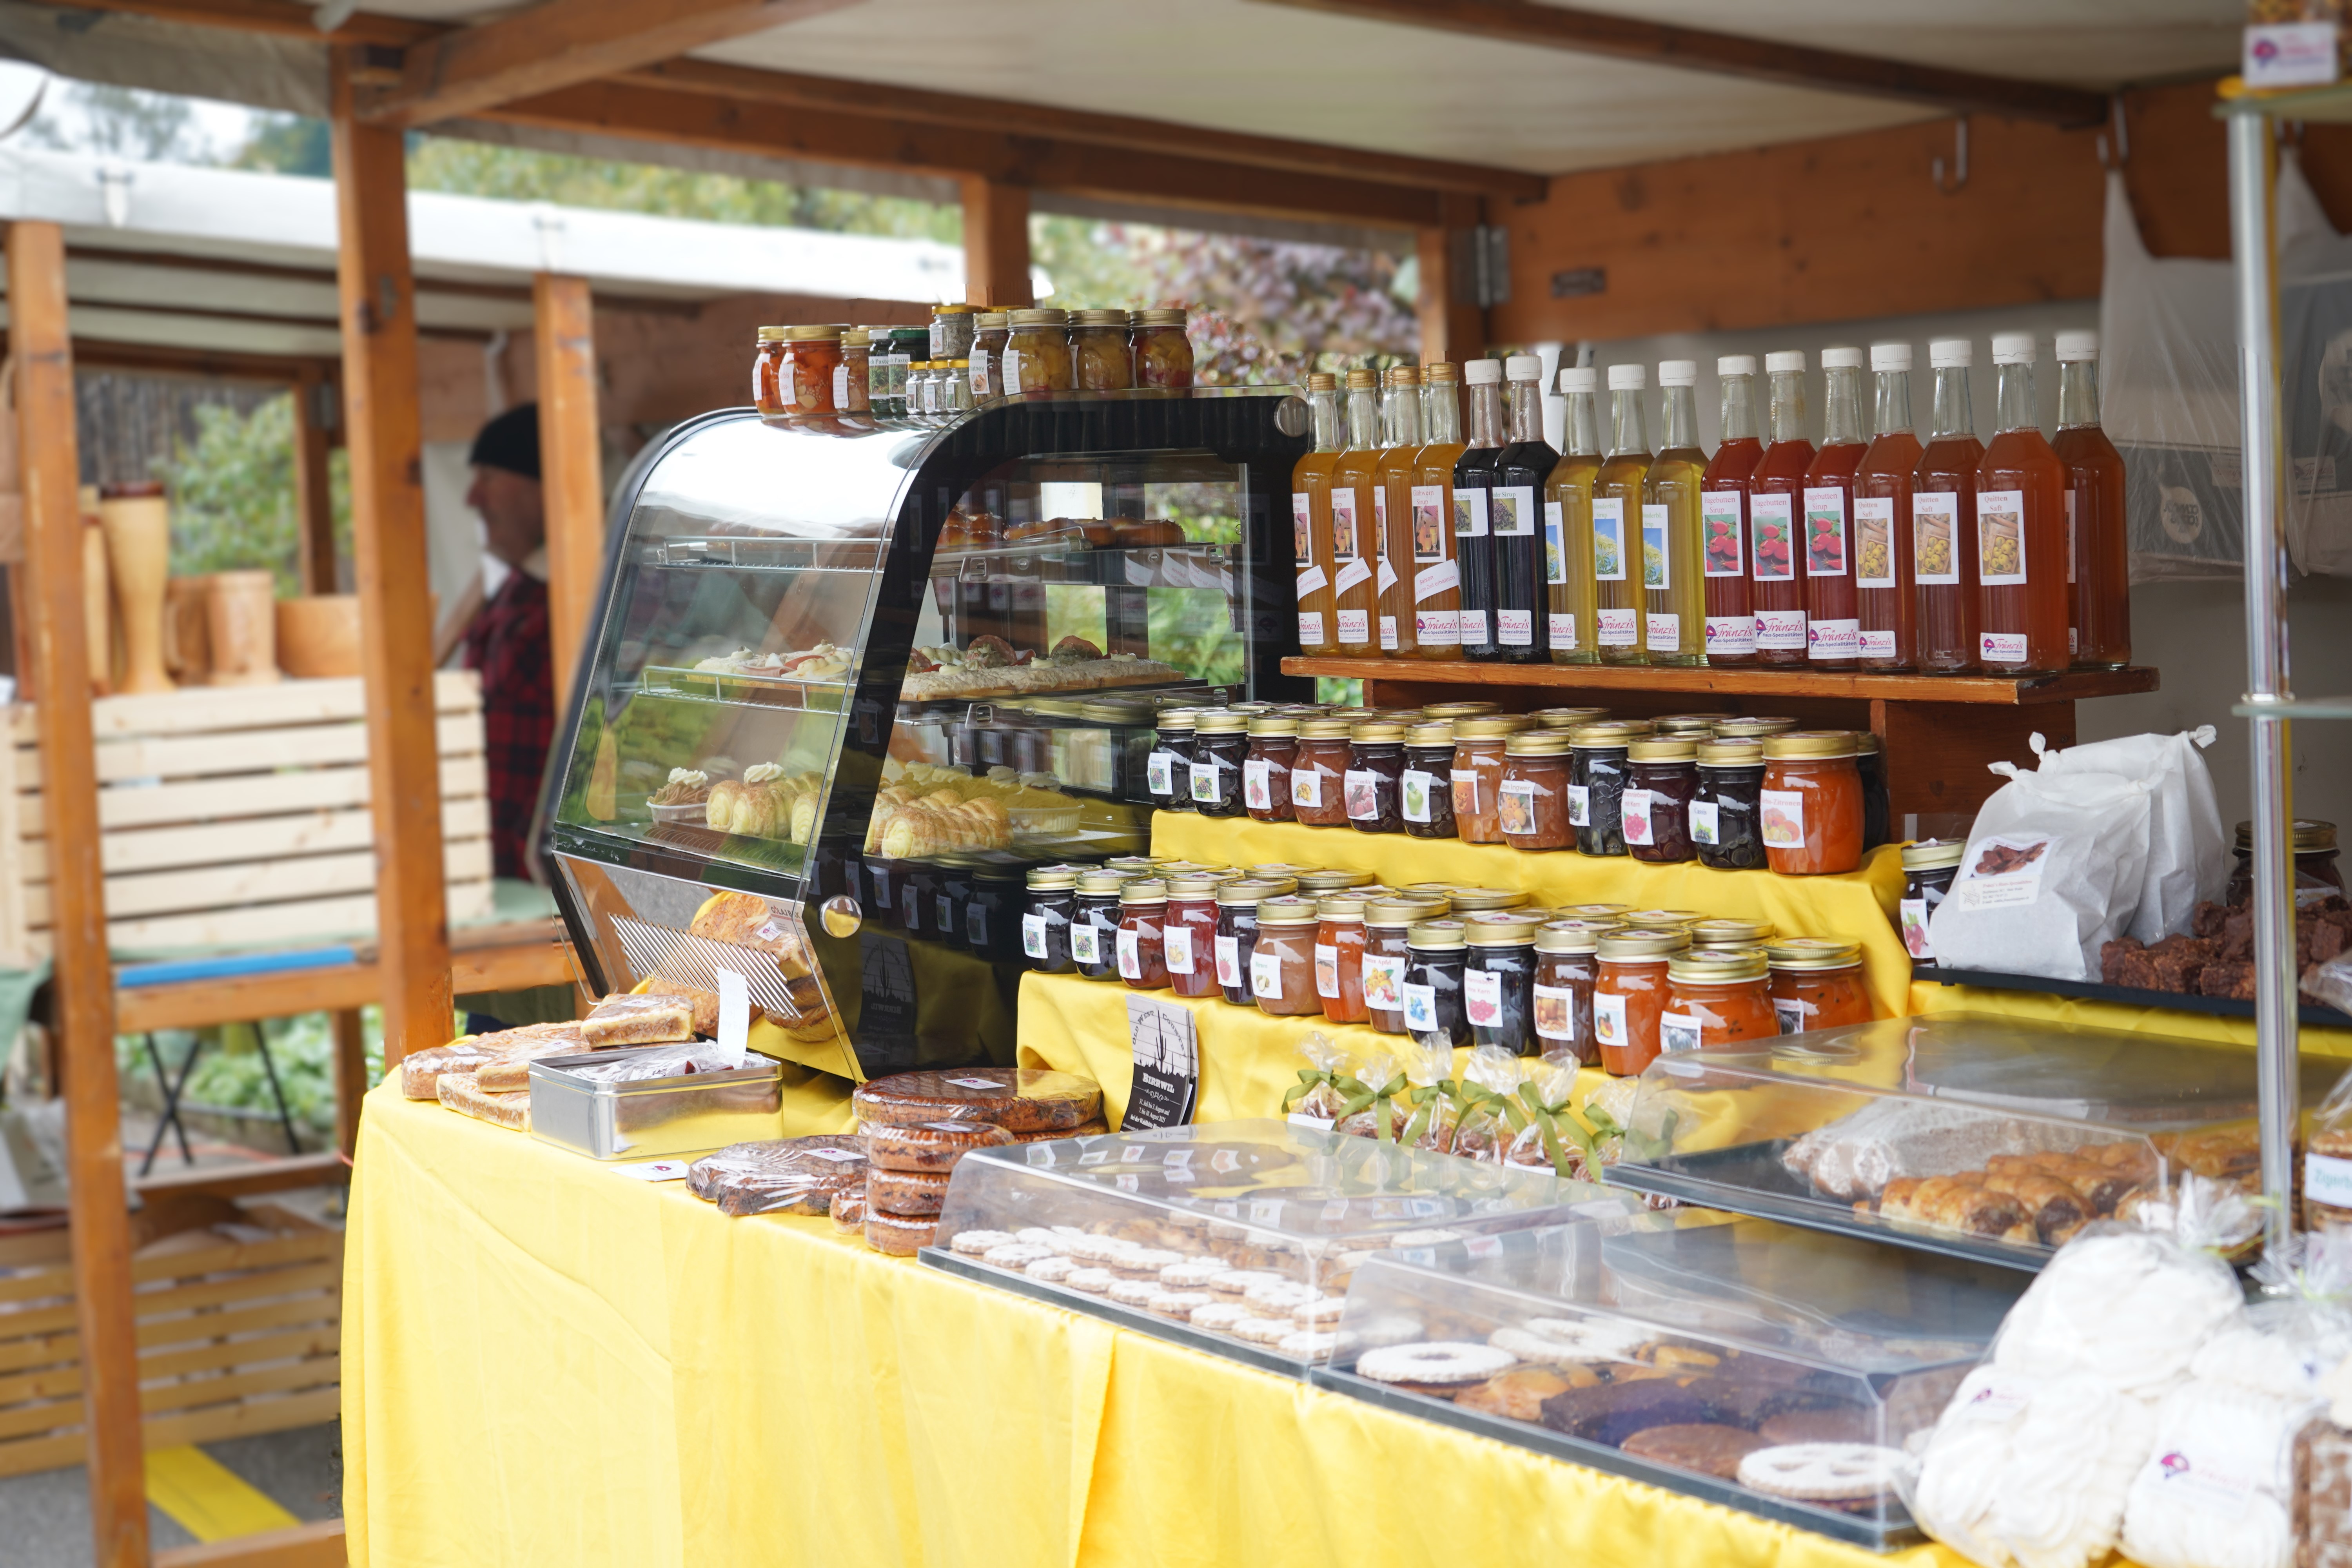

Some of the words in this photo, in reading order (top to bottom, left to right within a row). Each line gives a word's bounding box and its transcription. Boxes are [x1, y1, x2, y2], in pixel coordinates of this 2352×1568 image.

[1705, 497, 1735, 505] Hagebutten
[1806, 493, 1837, 501] Hagebutten
[1985, 495, 2007, 503] Quitten
[1754, 499, 1787, 508] Hagebutten
[1347, 568, 1365, 580] erhältlich
[1419, 575, 1434, 585] Saison
[1435, 575, 1455, 586] erhältlich
[1694, 807, 1707, 815] Cassis
[1378, 957, 1391, 965] Apfel
[1137, 1011, 1154, 1025] WEST
[1163, 1013, 1187, 1058] COUNTRY
[1142, 1072, 1175, 1093] BIRRWIL
[1155, 1104, 1165, 1114] August
[1150, 1111, 1159, 1120] August
